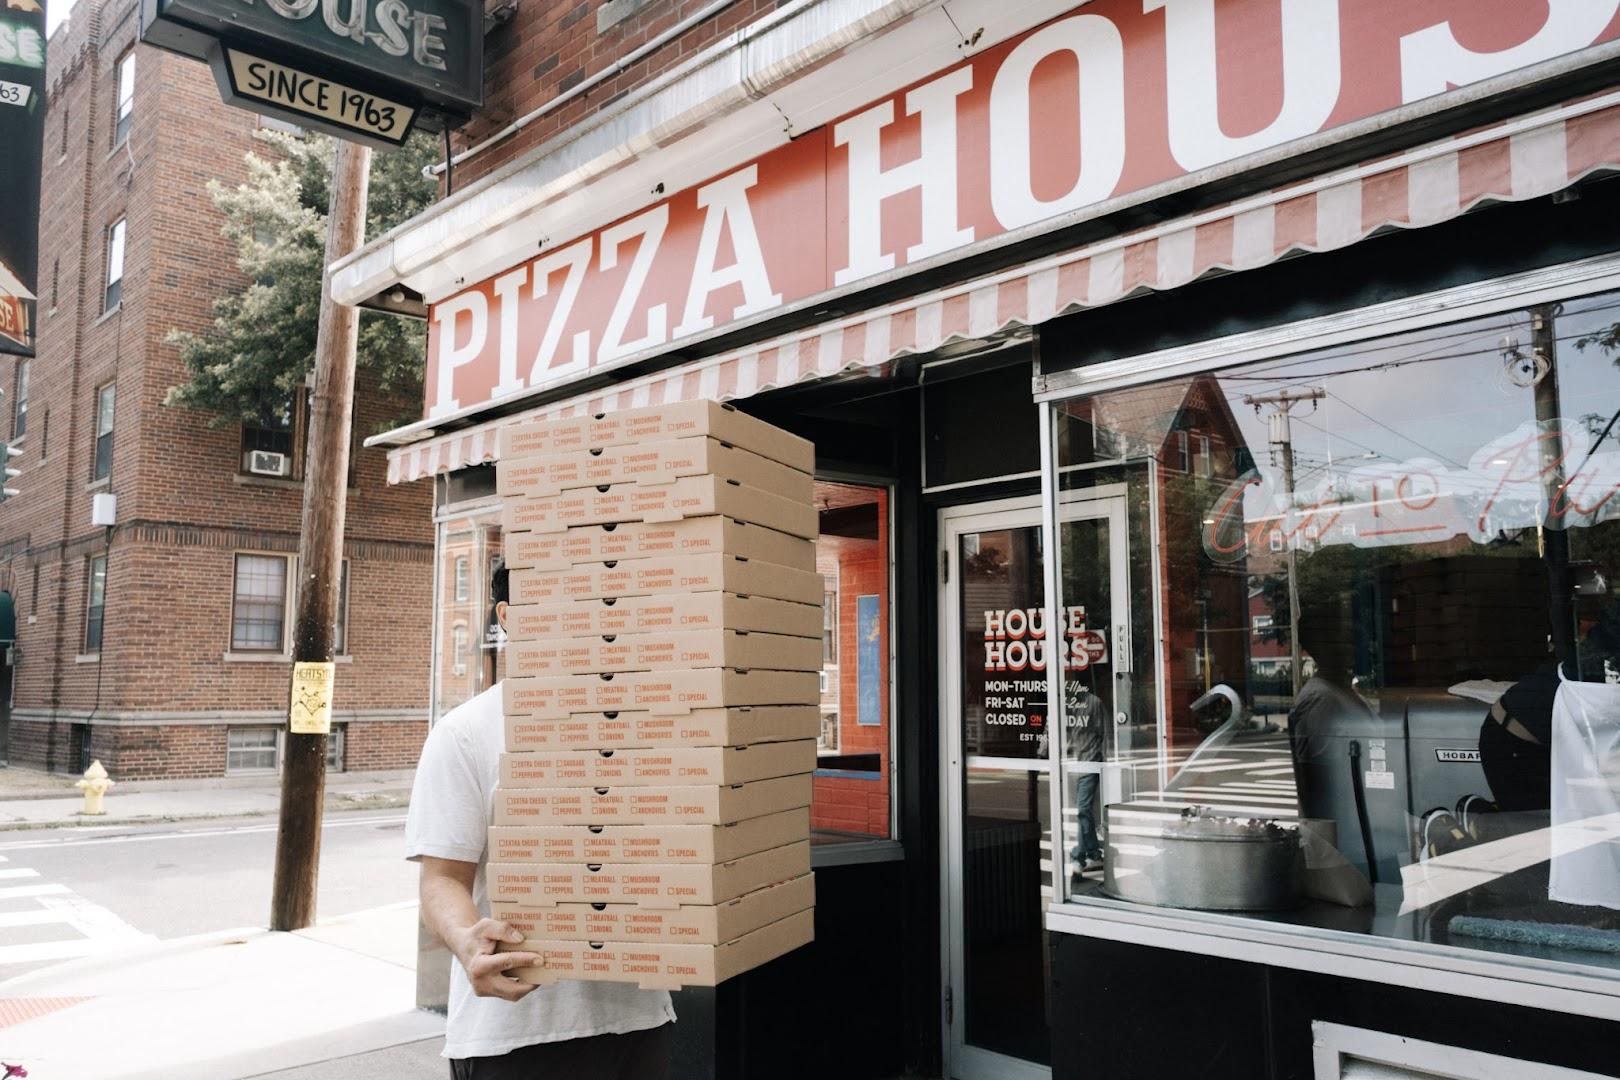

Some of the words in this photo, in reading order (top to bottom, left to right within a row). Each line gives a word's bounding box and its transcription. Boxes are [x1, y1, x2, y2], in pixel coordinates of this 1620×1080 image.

[247, 0, 447, 70] USE
[248, 63, 330, 112] SINCE
[340, 90, 395, 133] 1963
[429, 163, 782, 420] PIZZA
[607, 534, 632, 543] MEATBALL
[689, 538, 711, 547] SPECIAL
[607, 572, 632, 581] MEATBALL
[688, 576, 710, 585] SPECIAL
[539, 614, 557, 622] CHEESE
[568, 612, 590, 620] SAUSAGE
[606, 609, 631, 618] MEATBALL
[688, 615, 709, 623] SPECIAL
[525, 626, 551, 634] PEPPERONI
[569, 623, 591, 631] PEPPERS
[606, 621, 626, 629] ONIONS
[644, 618, 672, 627] ANCHOVIES
[984, 605, 1088, 638] HOUE
[538, 650, 557, 658] CHEESE
[568, 648, 590, 656] SAUSAGE
[606, 646, 632, 654] MEATBALL
[689, 652, 710, 660] SPECIAL
[524, 661, 551, 670] PEPPERONI
[569, 659, 591, 667] PEPPERS
[607, 657, 626, 665] ONIONS
[644, 654, 673, 663] ANCHOVIES
[985, 680, 1048, 692] MON-THURS
[534, 689, 553, 697] CHEESE
[564, 688, 587, 696] SAUSAGE
[603, 686, 629, 694] MEATBALL
[520, 700, 547, 708] PEPPERONI
[565, 698, 588, 707] PEPPERS
[603, 697, 623, 705] ONIONS
[641, 695, 670, 703] ANCHOVIES
[686, 693, 708, 701] SPECIAL
[985, 697, 1025, 709] FRI-SAT
[985, 713, 1027, 726] CLOSED
[1030, 715, 1042, 723] ON
[605, 722, 631, 730] MEATBALL
[520, 736, 548, 744] PEPPERONI
[566, 734, 589, 742] PEPPERS
[644, 731, 673, 740] ANCHOVIES
[689, 730, 710, 738] SPECIAL
[1020, 733, 1034, 741] EST
[1443, 752, 1481, 760] HOBAR
[602, 759, 628, 767] MEATBALL
[516, 771, 544, 779] PEPPERONI
[563, 770, 586, 778] PEPPERS
[683, 806, 705, 814] SPECIAL
[506, 850, 533, 858] PEPPERONI
[551, 850, 575, 858] PEPPERS
[629, 850, 659, 858] ANCHOVIES
[675, 849, 697, 857] SPECIAL
[678, 927, 699, 935] SPECIAL
[550, 962, 574, 970] PEPPERS
[590, 964, 610, 972] ONIONS
[629, 965, 658, 973] ANCHOVIES
